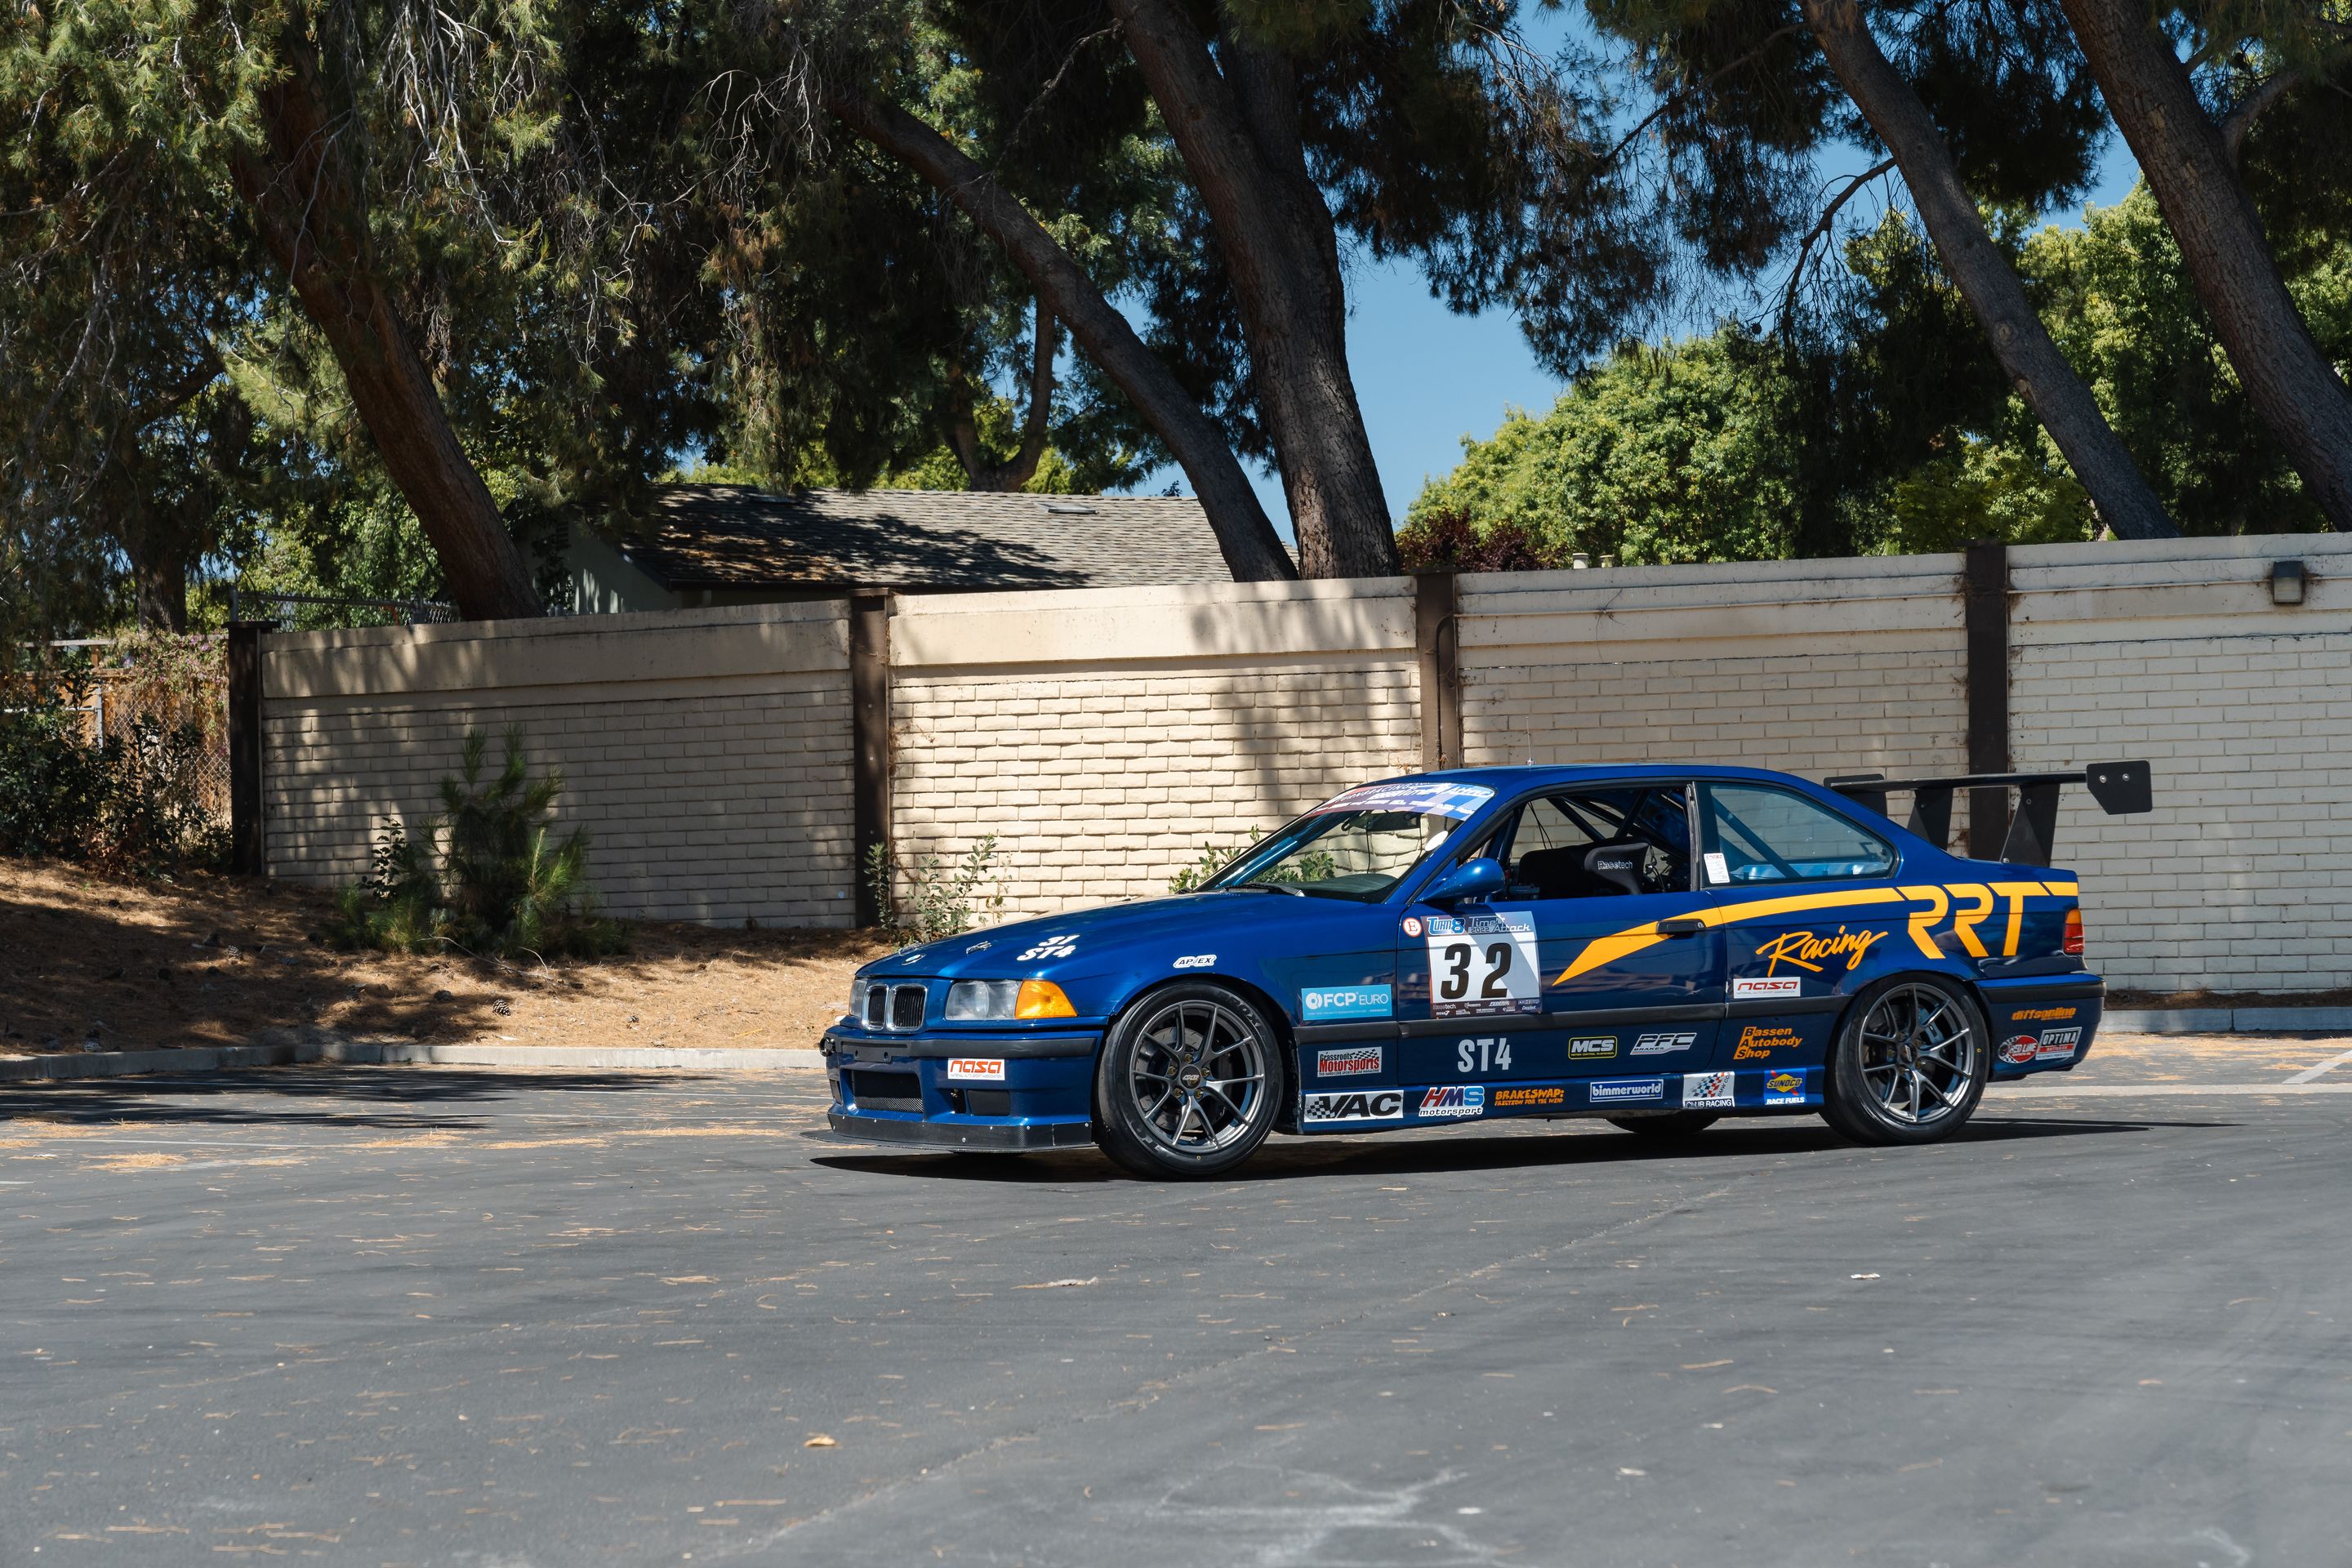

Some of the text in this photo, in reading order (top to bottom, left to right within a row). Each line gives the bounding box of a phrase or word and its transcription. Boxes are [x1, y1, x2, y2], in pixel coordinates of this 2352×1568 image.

[1407, 920, 1418, 932] E
[1469, 916, 1497, 929] Time
[1895, 882, 2051, 959] RRT
[1492, 922, 1531, 933] Attack
[1017, 945, 1076, 961] ST4
[1756, 925, 1888, 977] Racing
[1441, 942, 1512, 999] 32
[1324, 992, 1388, 1007] FCP EURO
[1744, 1027, 1793, 1036] Bassen
[1635, 1033, 1696, 1047] PFC
[1740, 1036, 1802, 1047] Autobody
[2042, 1032, 2077, 1045] OPTIMA
[1571, 1040, 1615, 1053] MCS
[2022, 1043, 2038, 1052] LINE
[1320, 1052, 1353, 1061] Grassroots
[1458, 1038, 1511, 1072] ST4
[1737, 1049, 1771, 1058] Shop
[1319, 1058, 1379, 1075] Motorsports
[1768, 1078, 1802, 1088] SUNOCO
[1420, 1086, 1485, 1107] HMS
[1592, 1083, 1661, 1097] bimmerworld
[1316, 1093, 1401, 1119] VAC
[1705, 1099, 1731, 1107] RACING
[1419, 1107, 1483, 1117] motorsport
